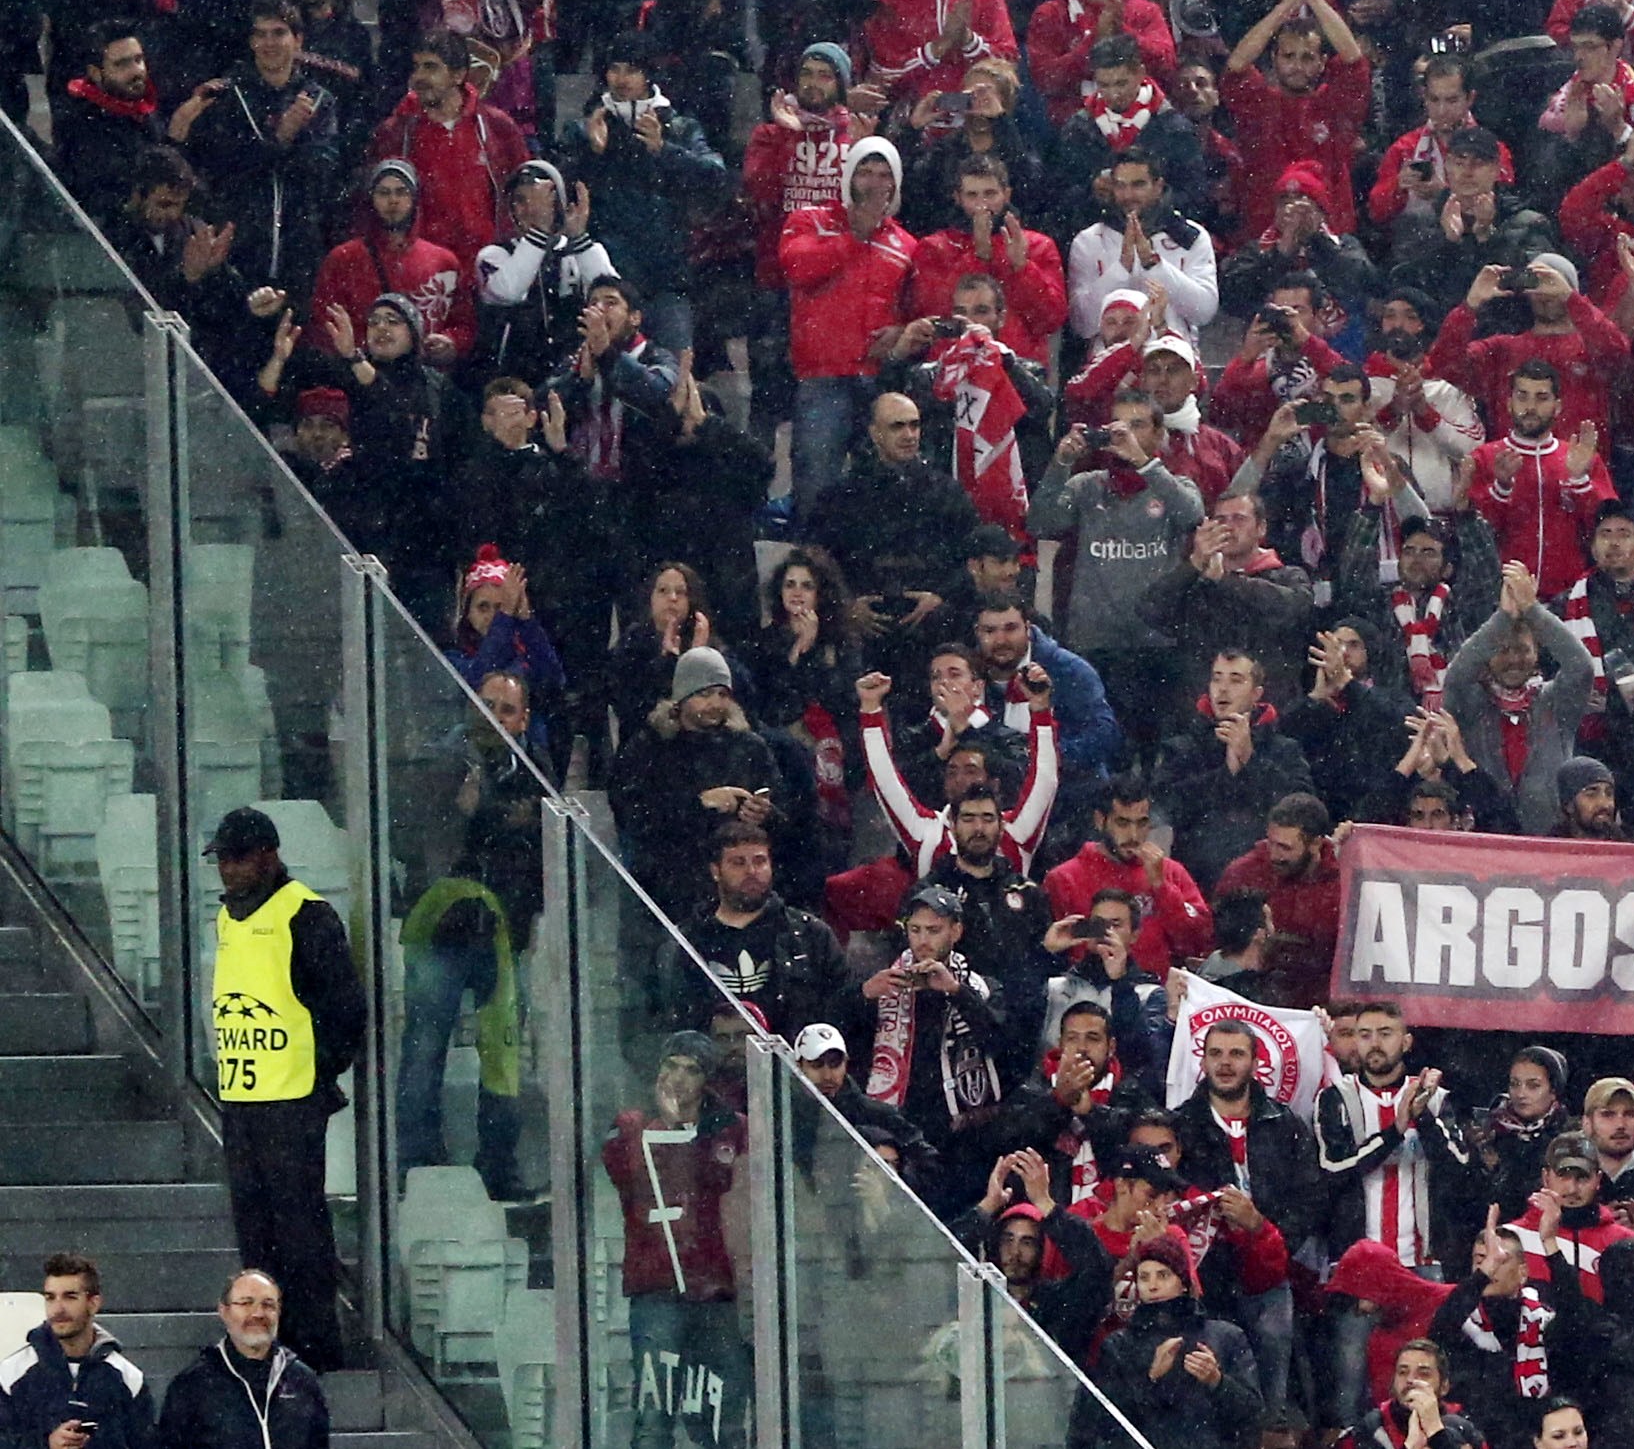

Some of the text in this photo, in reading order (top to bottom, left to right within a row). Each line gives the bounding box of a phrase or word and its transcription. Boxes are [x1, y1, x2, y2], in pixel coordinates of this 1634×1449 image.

[1089, 537, 1167, 560] citibank
[214, 1027, 288, 1051] EWARD
[1201, 1005, 1293, 1051] ΟΛΥΜΠΙΑΚΟΣ
